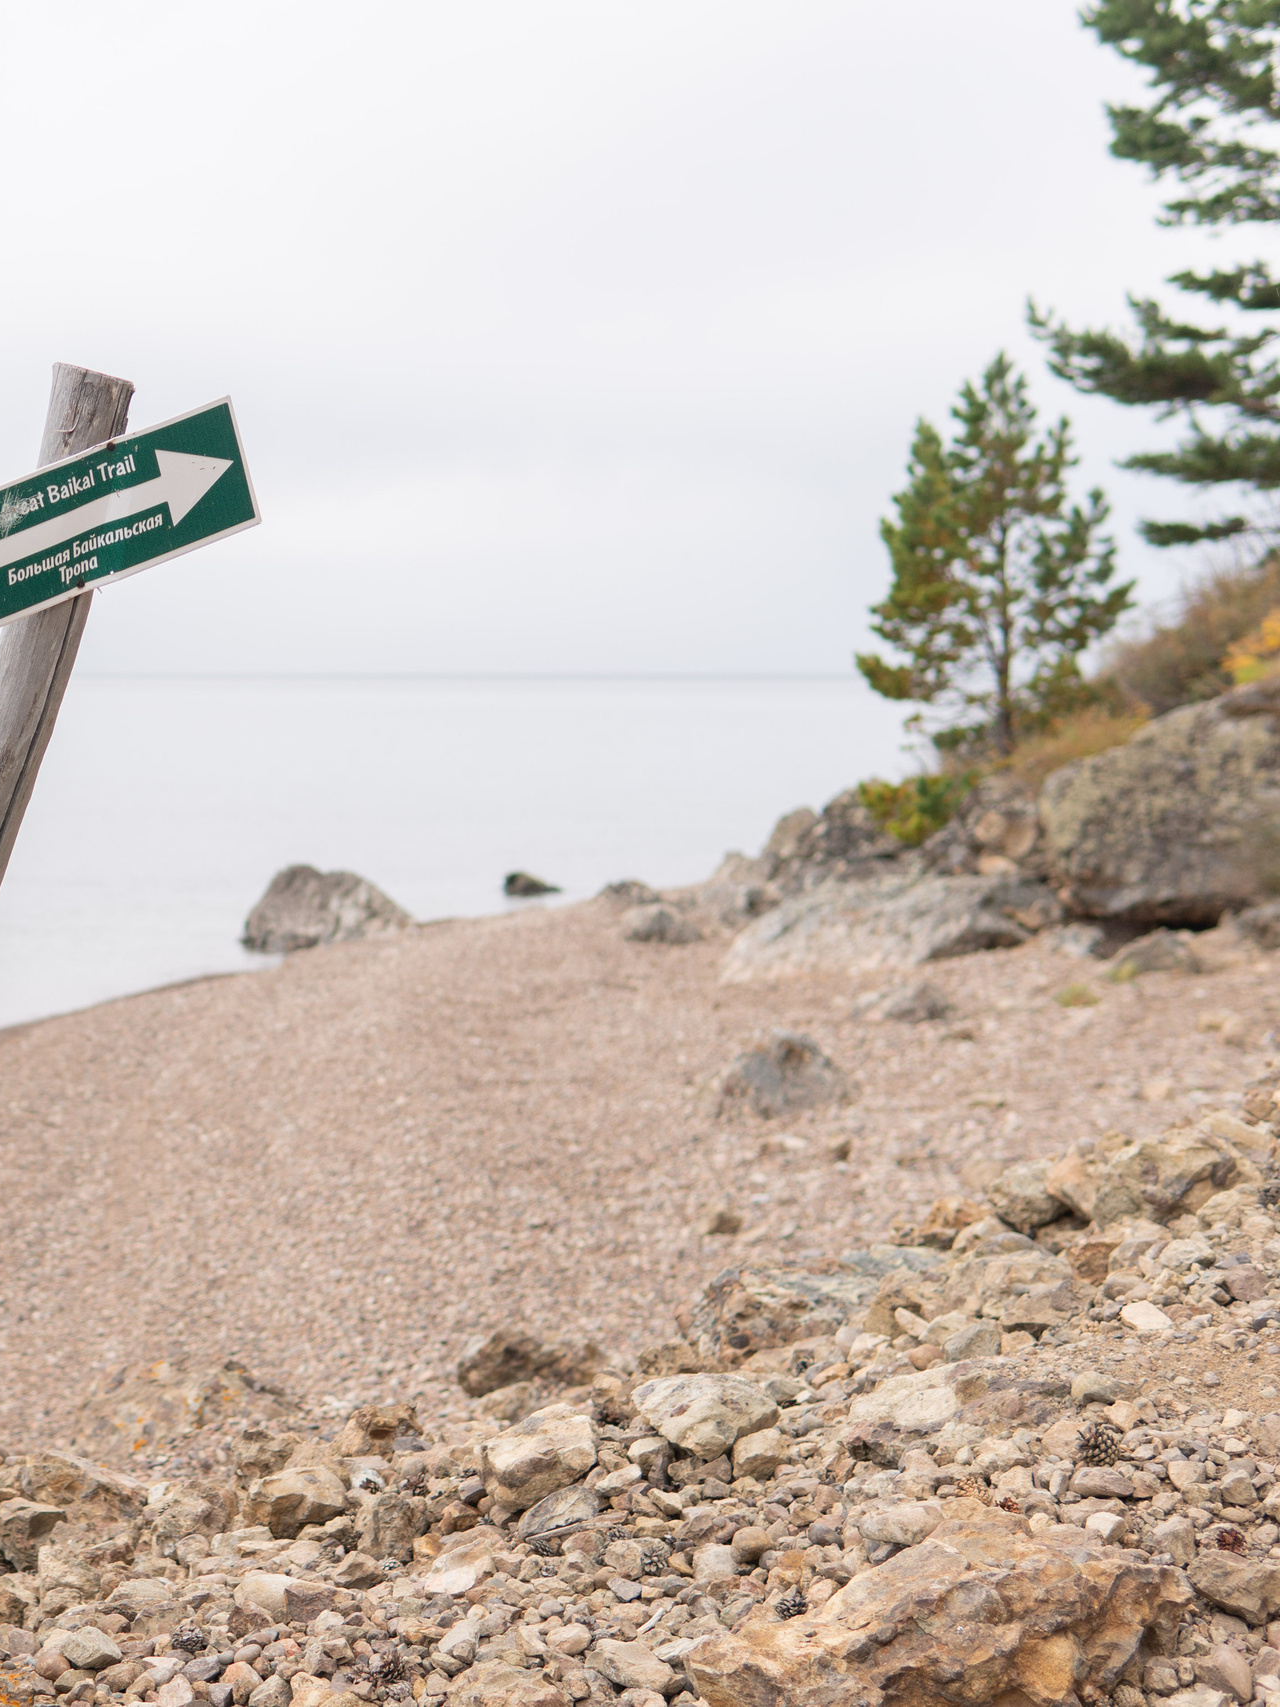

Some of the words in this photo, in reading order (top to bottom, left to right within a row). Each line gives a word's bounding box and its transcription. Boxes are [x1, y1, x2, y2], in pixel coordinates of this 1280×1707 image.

[0, 491, 45, 530] eat
[46, 469, 96, 504] Baikal
[96, 454, 136, 482] Trail
[7, 548, 71, 586] Большая
[72, 513, 163, 559] Байкальская
[58, 555, 99, 584] Тропа
